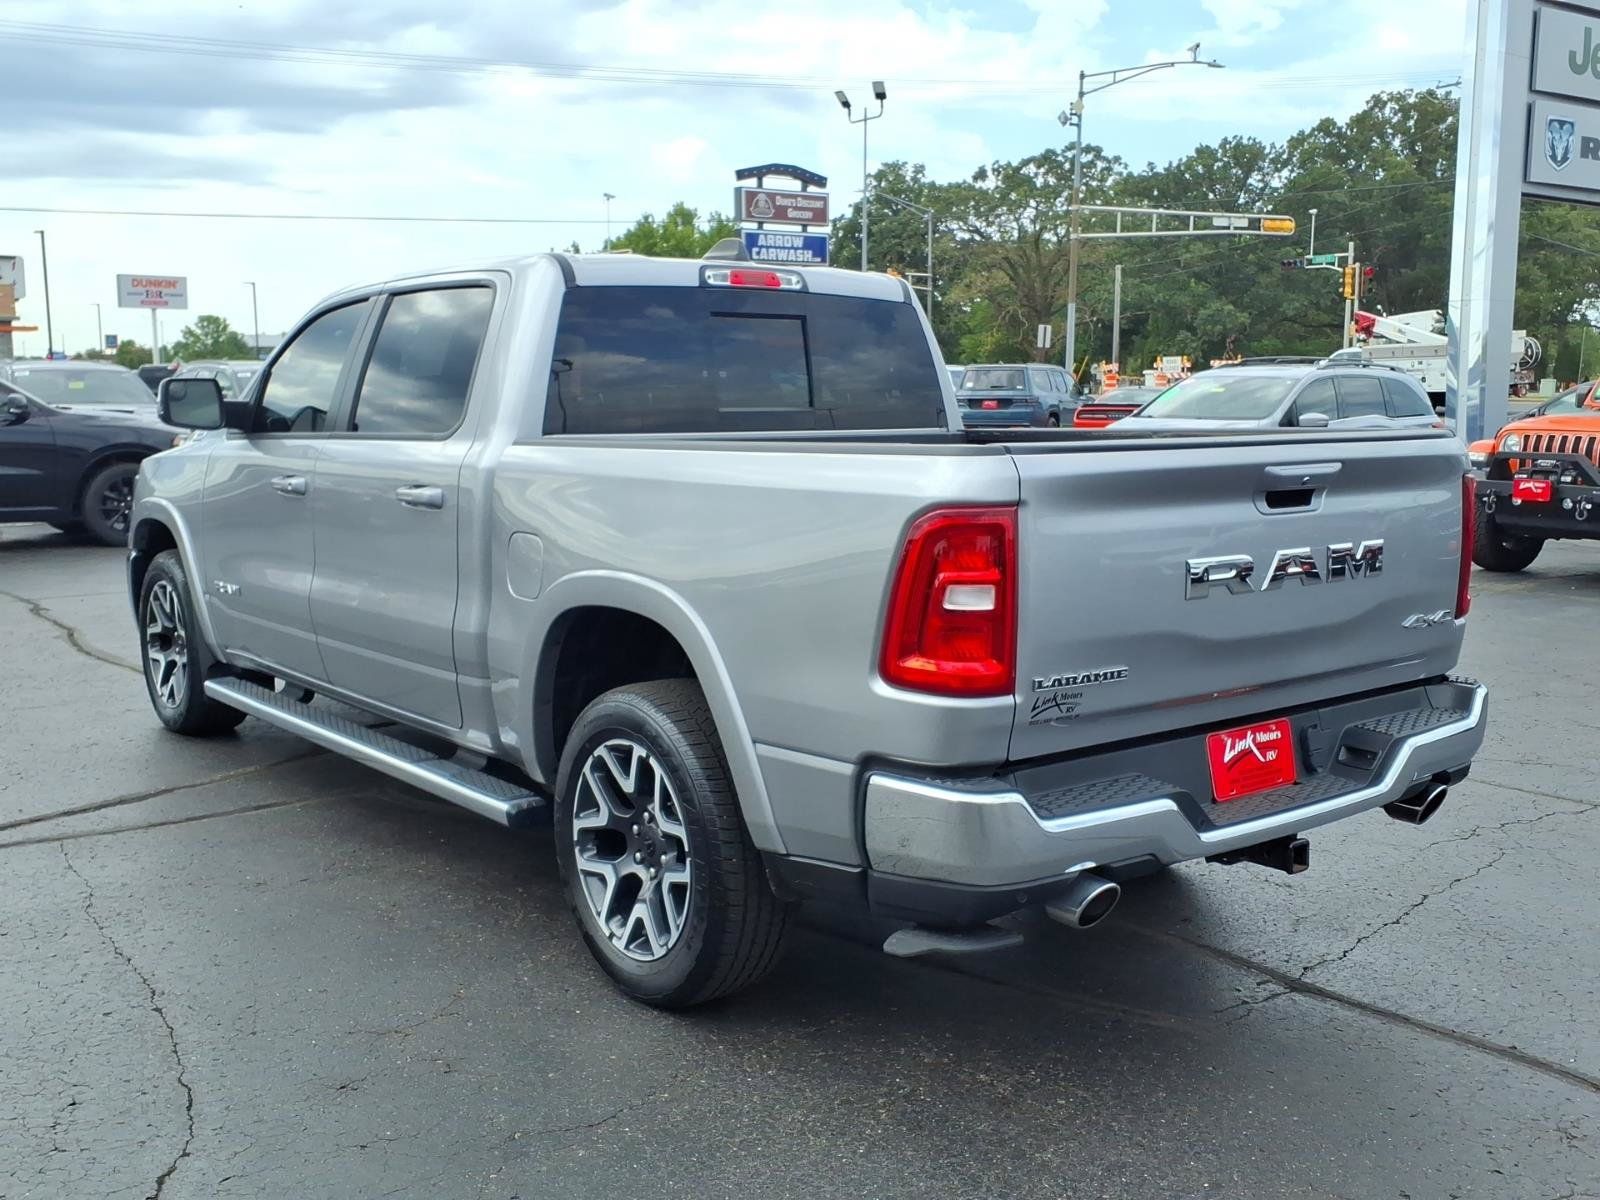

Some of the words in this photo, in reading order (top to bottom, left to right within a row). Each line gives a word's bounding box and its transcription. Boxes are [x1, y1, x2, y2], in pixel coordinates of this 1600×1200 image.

[757, 234, 804, 248] ARROW
[751, 248, 813, 262] CARWASH
[1184, 538, 1385, 601] RAM
[1032, 666, 1129, 692] LARAMIE
[1030, 691, 1064, 714] Link
[1059, 691, 1083, 702] Motors
[1223, 730, 1266, 764] Link
[1255, 730, 1282, 744] Motors
[1265, 748, 1279, 762] RV
